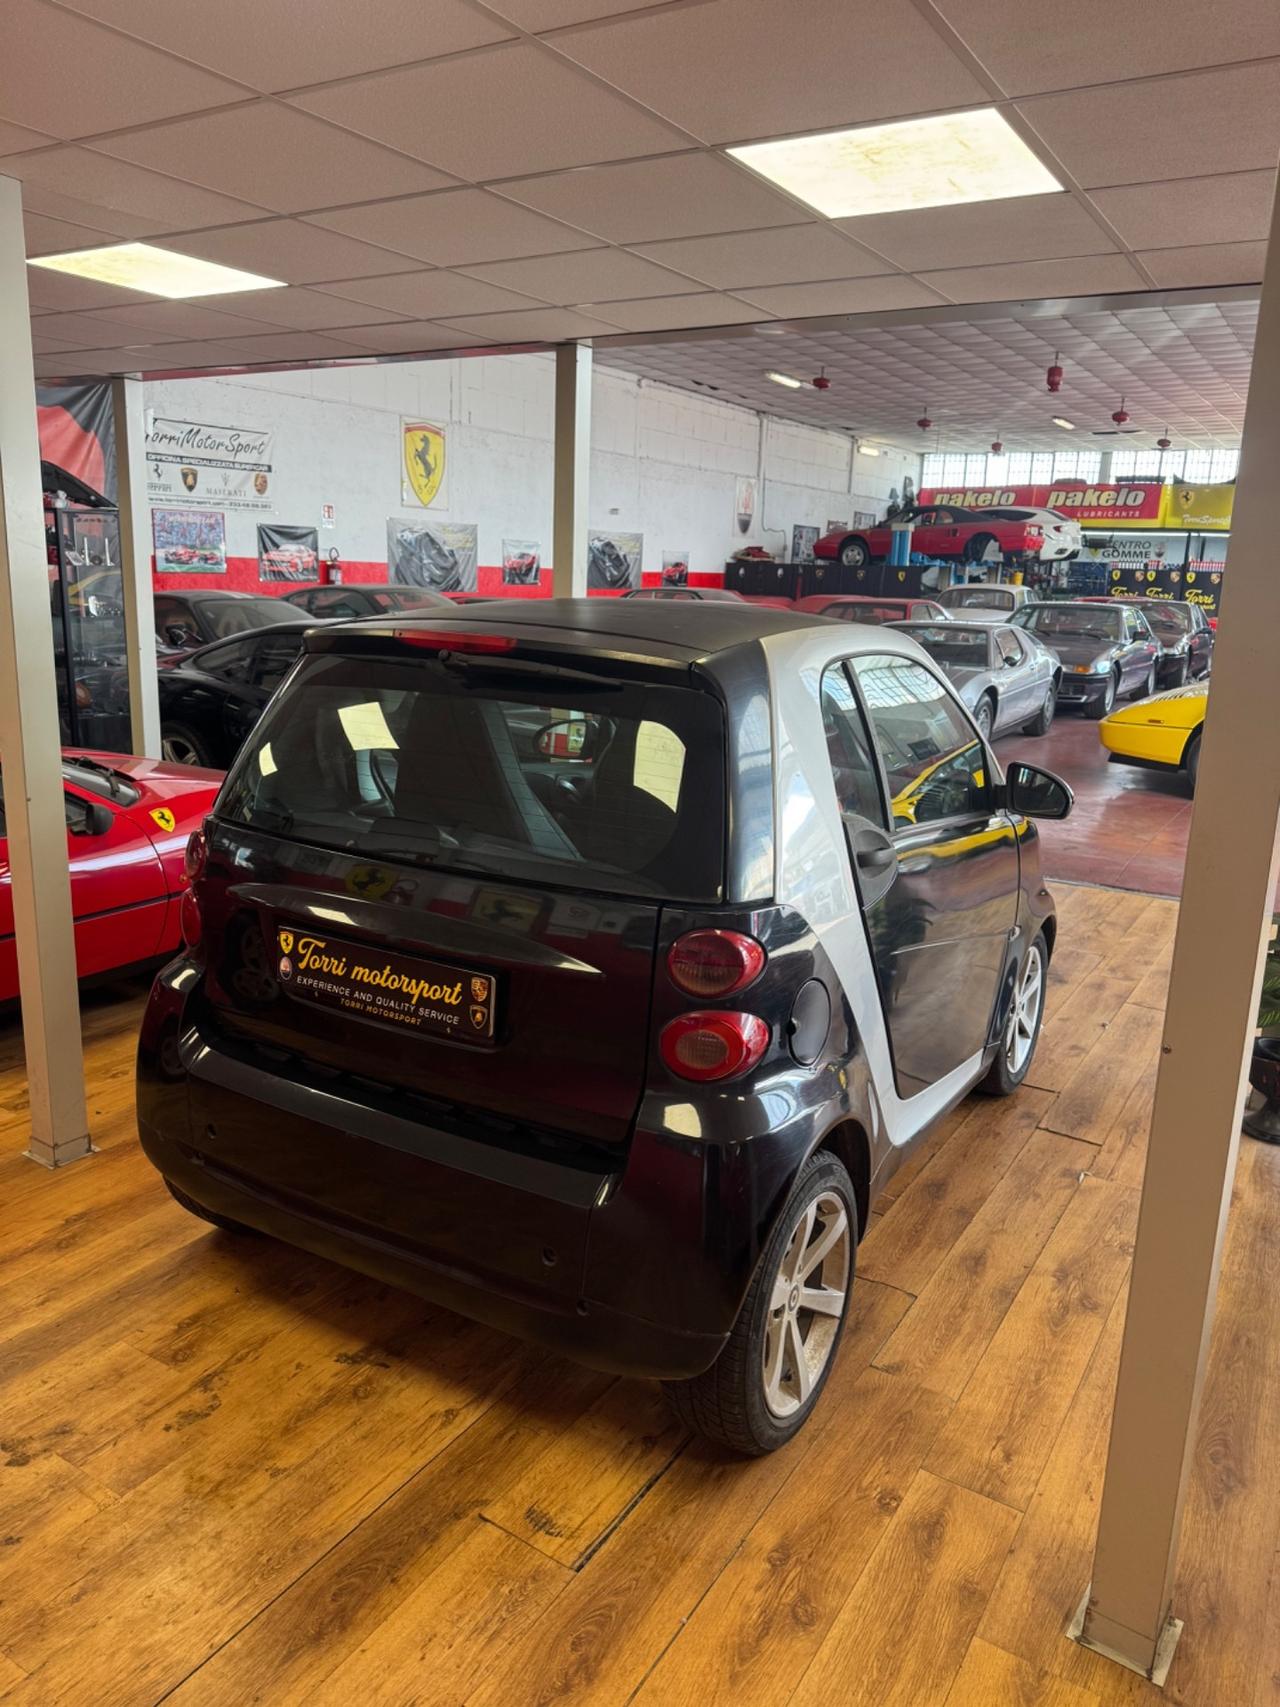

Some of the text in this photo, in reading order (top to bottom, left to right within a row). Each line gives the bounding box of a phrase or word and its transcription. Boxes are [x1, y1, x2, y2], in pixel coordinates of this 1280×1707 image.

[1047, 488, 1145, 509] pakelo
[1077, 510, 1140, 518] LUBRICANTS
[1102, 549, 1151, 559] GOMME
[1109, 540, 1151, 550] ENTRO
[1185, 588, 1214, 604] Torri
[298, 937, 462, 1005] Torri motorsport
[296, 975, 460, 1025] EXPERIENCE AND QUALITY SERVICE
[340, 998, 422, 1026] TORRI MOTORSPORT
